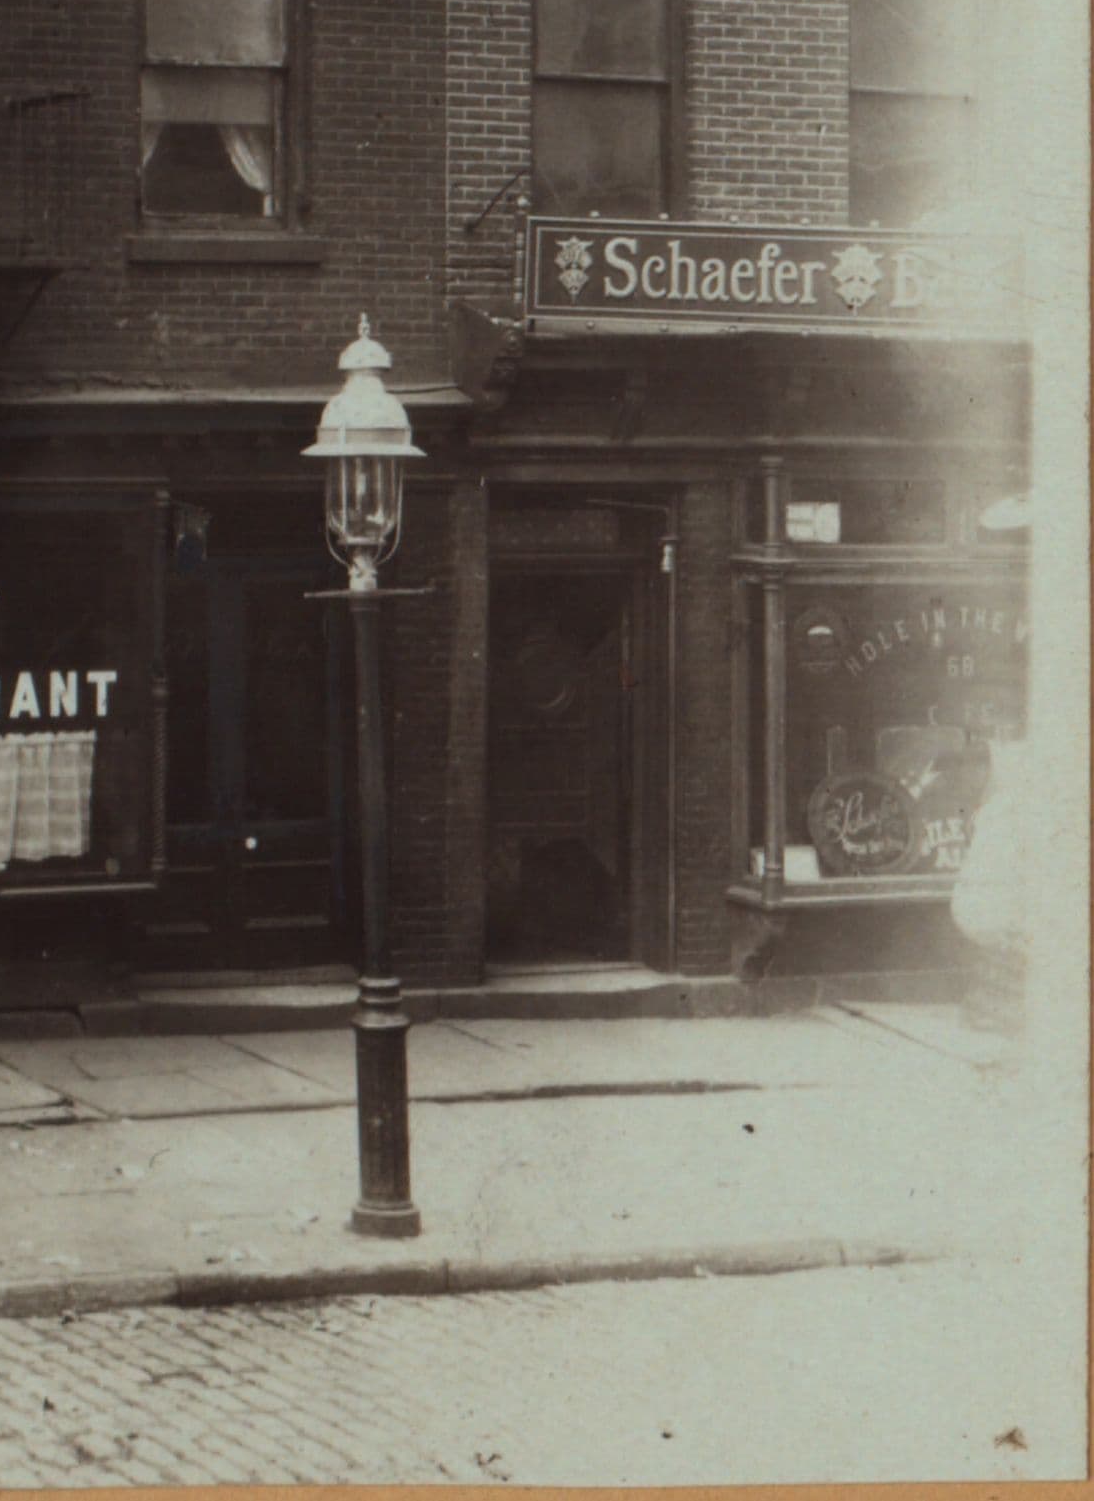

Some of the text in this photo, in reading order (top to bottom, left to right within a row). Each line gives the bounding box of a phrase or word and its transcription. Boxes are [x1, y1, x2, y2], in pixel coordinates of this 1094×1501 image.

[602, 236, 827, 306] Schaefer
[845, 619, 910, 676] HOLE
[920, 608, 947, 632] IN
[960, 606, 1004, 634] THE
